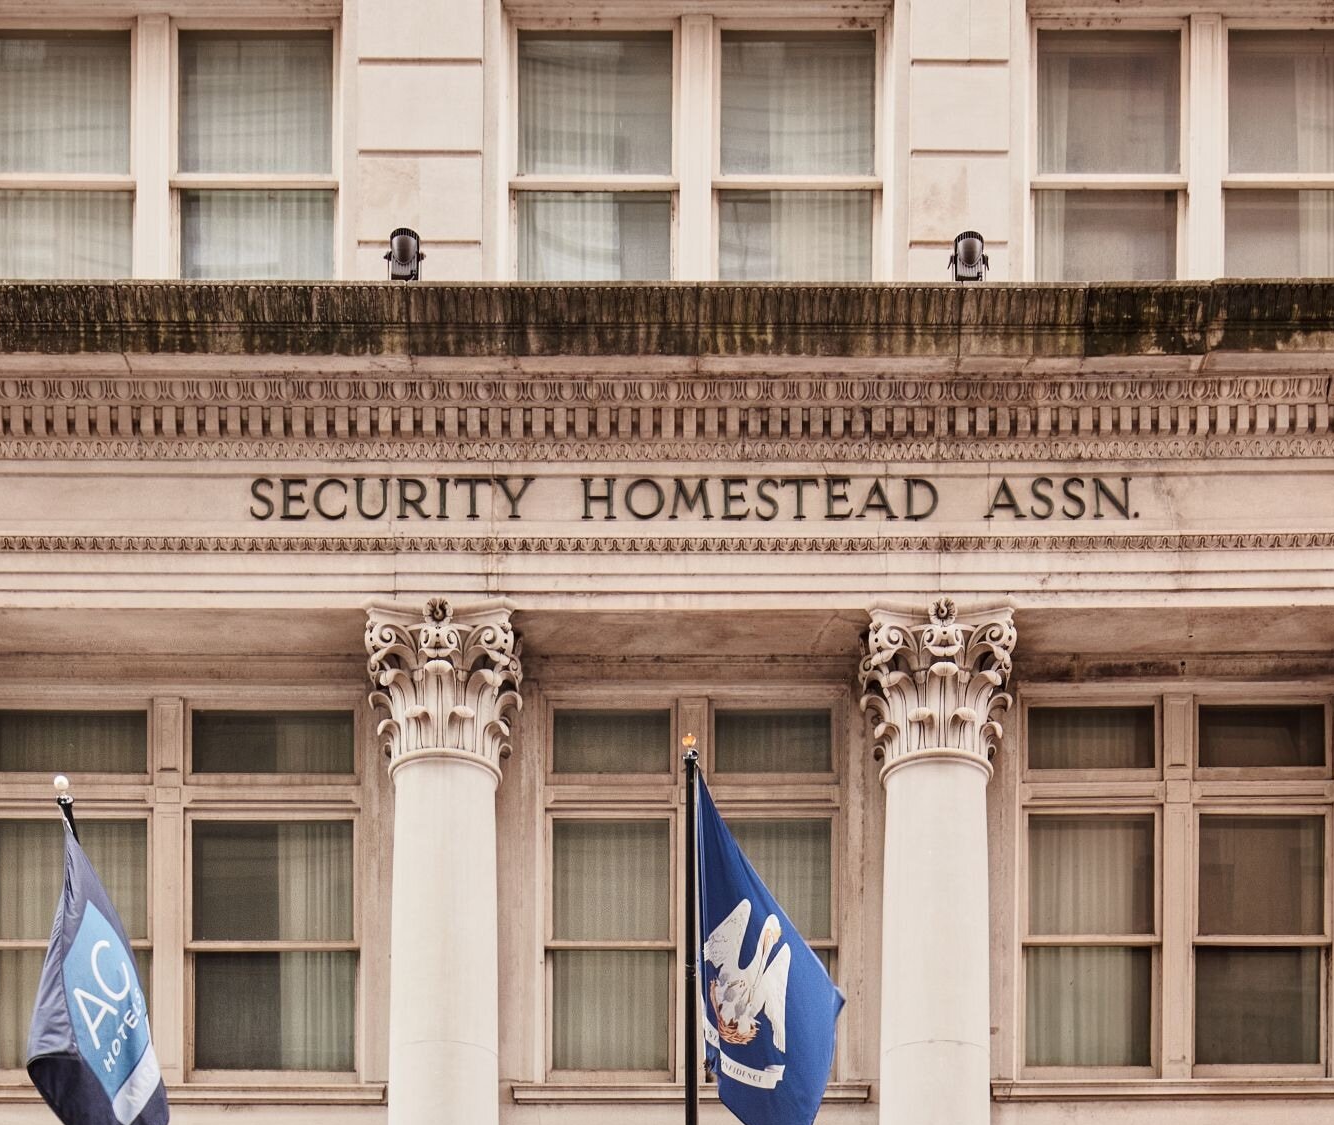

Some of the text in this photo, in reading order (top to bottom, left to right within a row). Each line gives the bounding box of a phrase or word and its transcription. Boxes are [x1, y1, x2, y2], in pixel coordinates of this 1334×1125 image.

[249, 477, 1142, 521] SECURITY HOMESTEAD ASSN.
[73, 940, 132, 1050] AC
